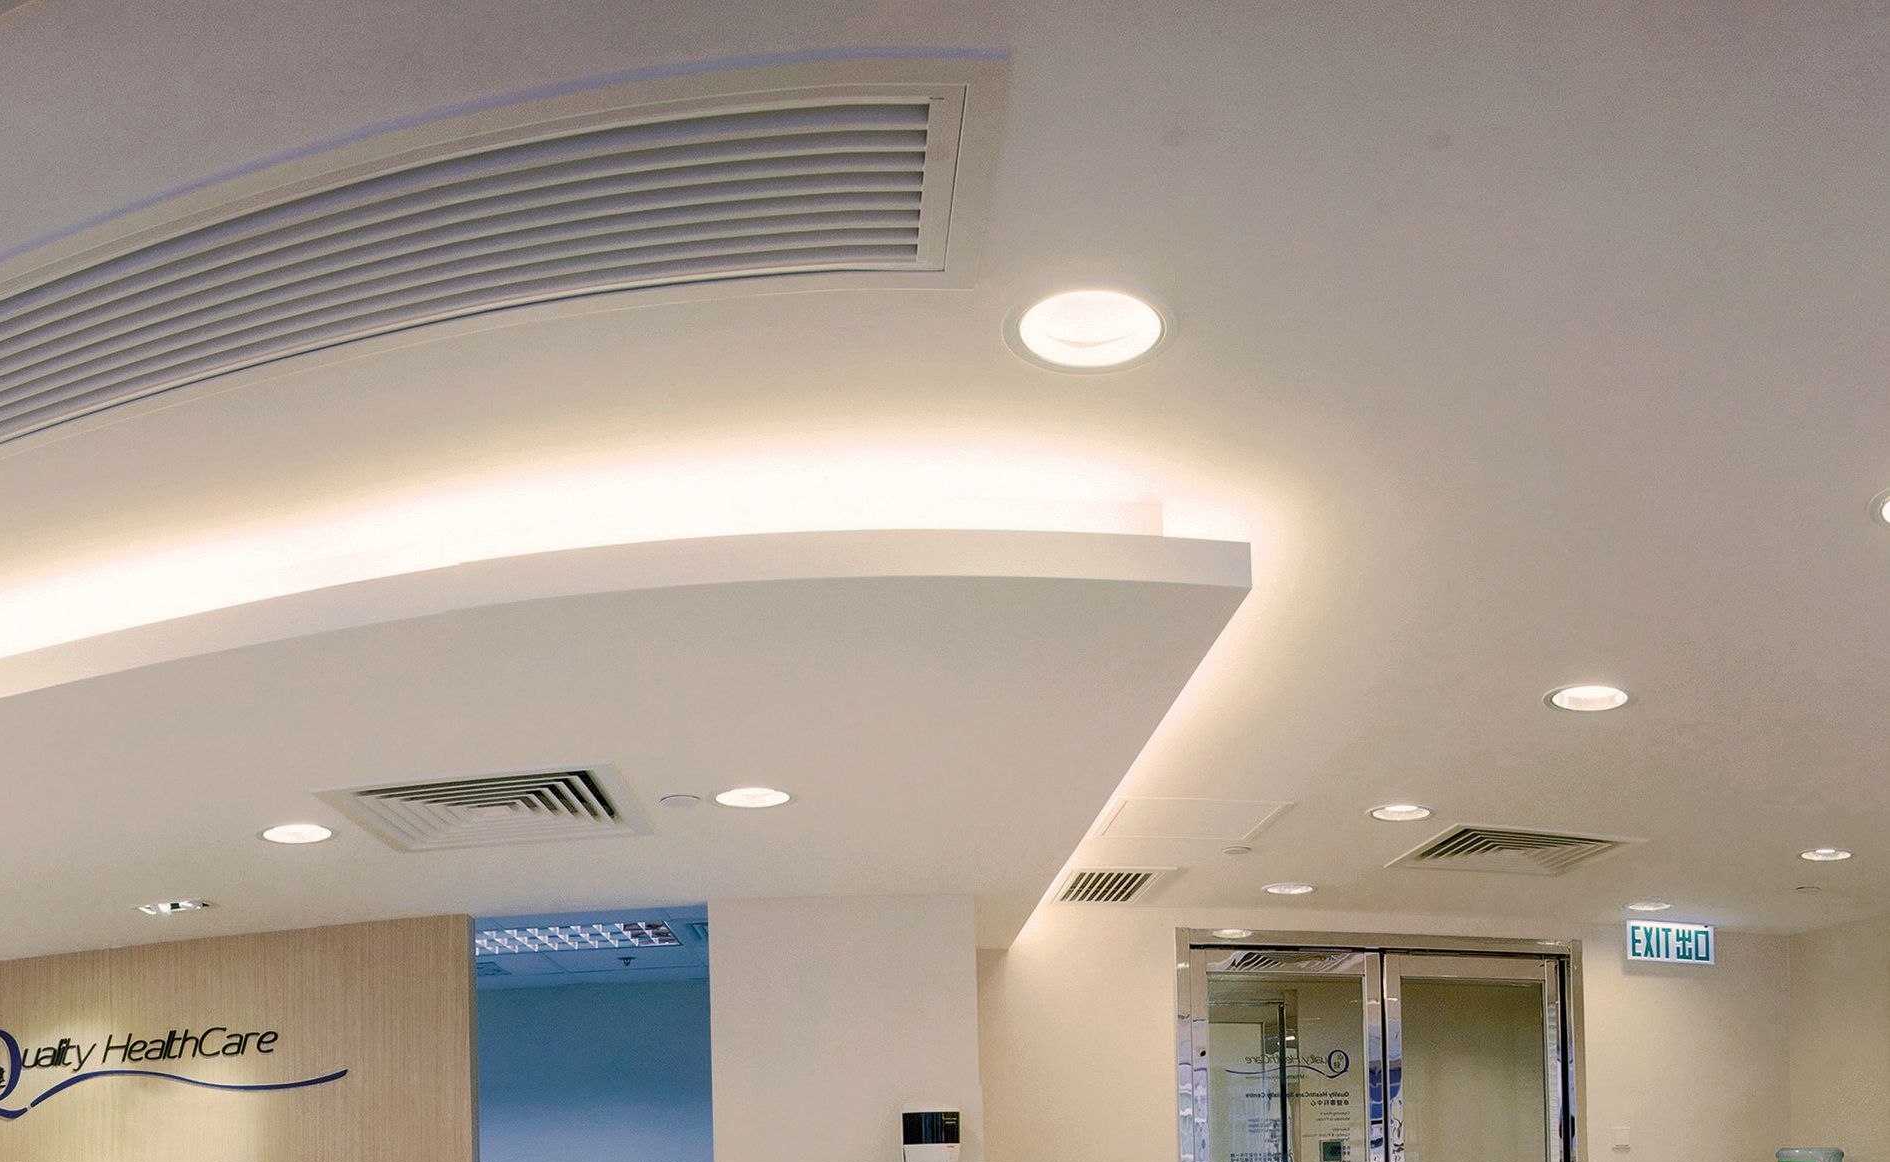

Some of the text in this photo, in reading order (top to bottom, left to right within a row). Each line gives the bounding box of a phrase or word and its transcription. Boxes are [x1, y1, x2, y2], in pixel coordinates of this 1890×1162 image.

[1631, 925, 1710, 961] EXIT 出口
[101, 1027, 278, 1064] HealthCare
